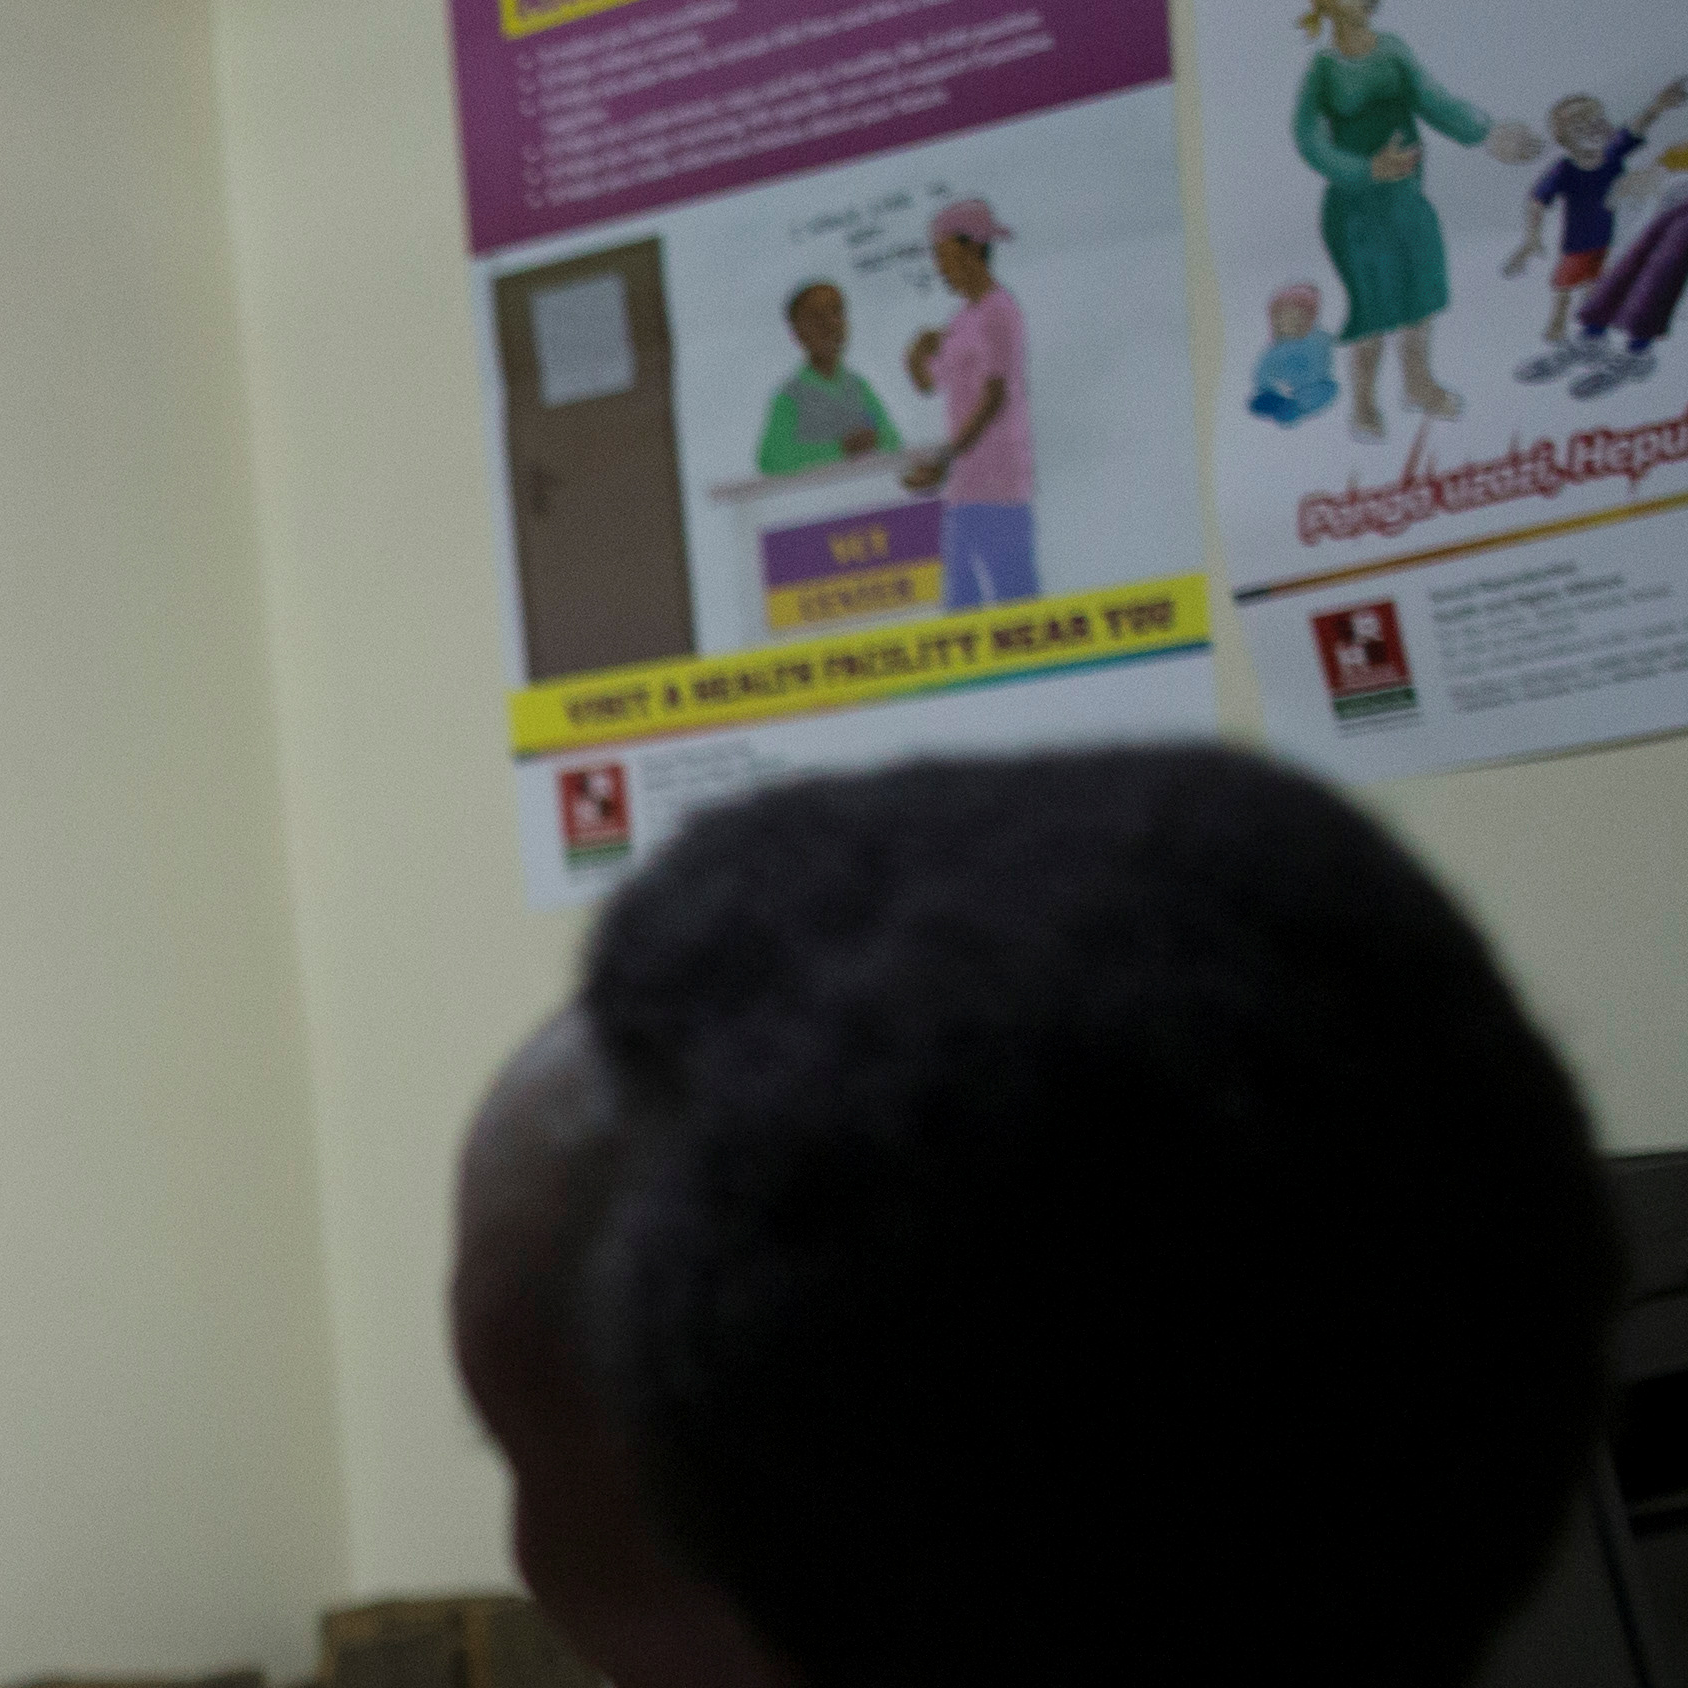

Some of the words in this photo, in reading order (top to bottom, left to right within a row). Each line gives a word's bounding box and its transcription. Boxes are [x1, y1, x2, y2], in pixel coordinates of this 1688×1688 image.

[693, 657, 814, 703] HEALTH
[822, 629, 980, 687] FACILITY
[991, 612, 1089, 654] NEAR
[1104, 596, 1176, 639] YOU
